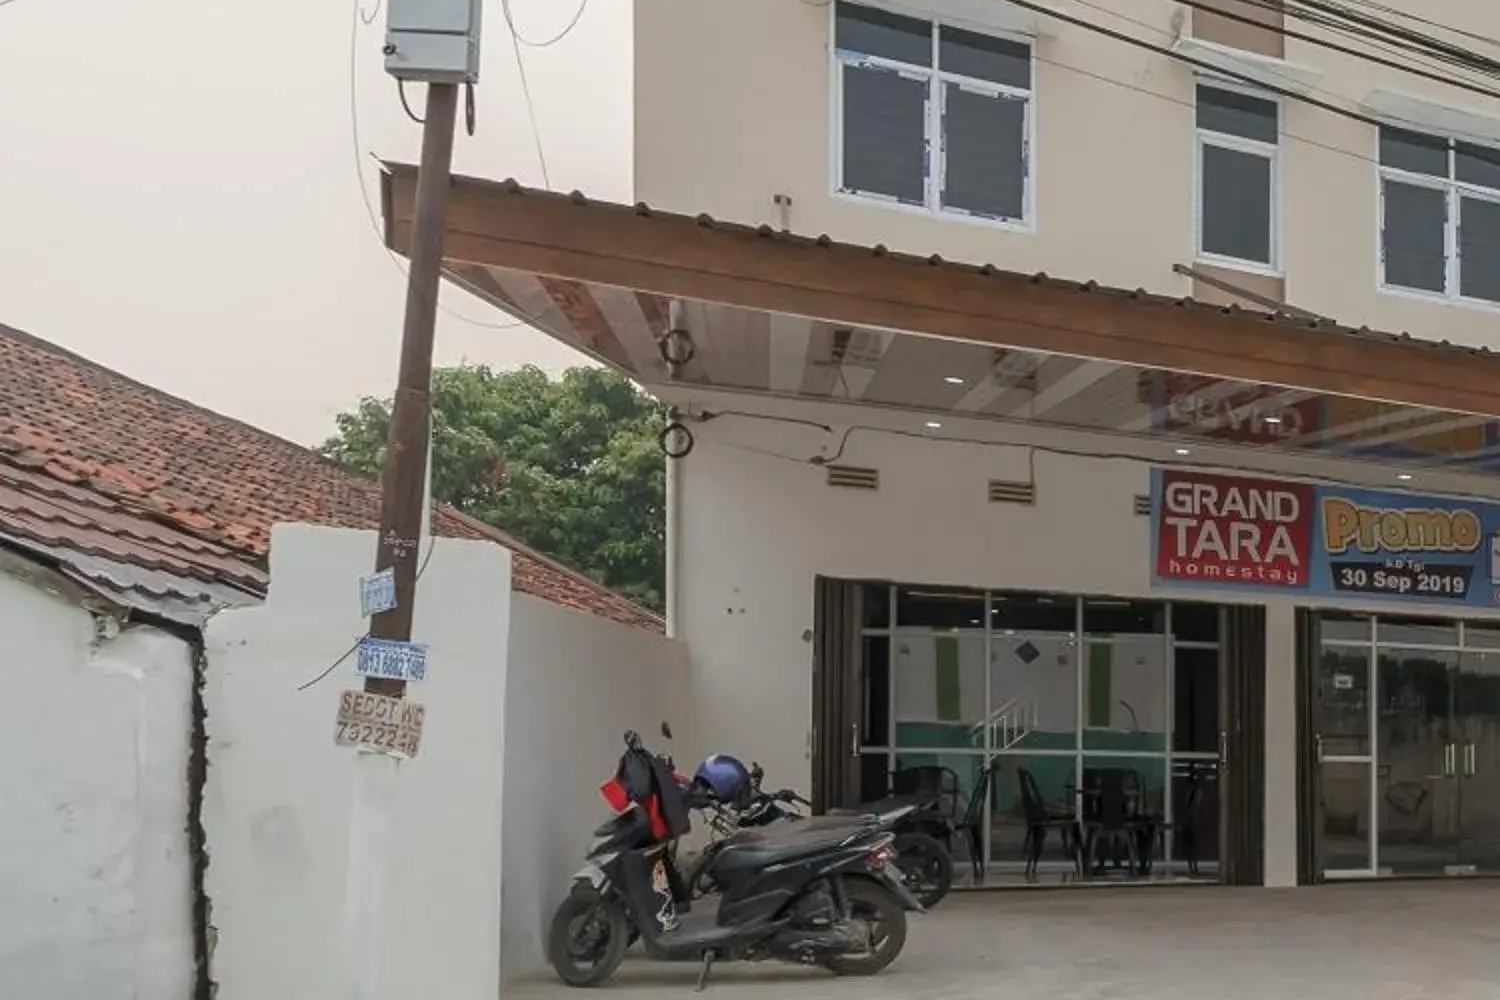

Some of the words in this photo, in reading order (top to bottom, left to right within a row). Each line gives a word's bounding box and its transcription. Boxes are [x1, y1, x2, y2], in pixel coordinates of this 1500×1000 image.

[1165, 481, 1299, 523] GRAND
[1165, 516, 1299, 565] TARA
[1321, 497, 1481, 552] Promo
[1169, 558, 1298, 585] homestay
[1341, 568, 1367, 587] 30
[1373, 570, 1411, 592] Sep
[1417, 573, 1464, 593] 2019
[341, 692, 399, 719] SEDOT
[401, 702, 426, 727] WC
